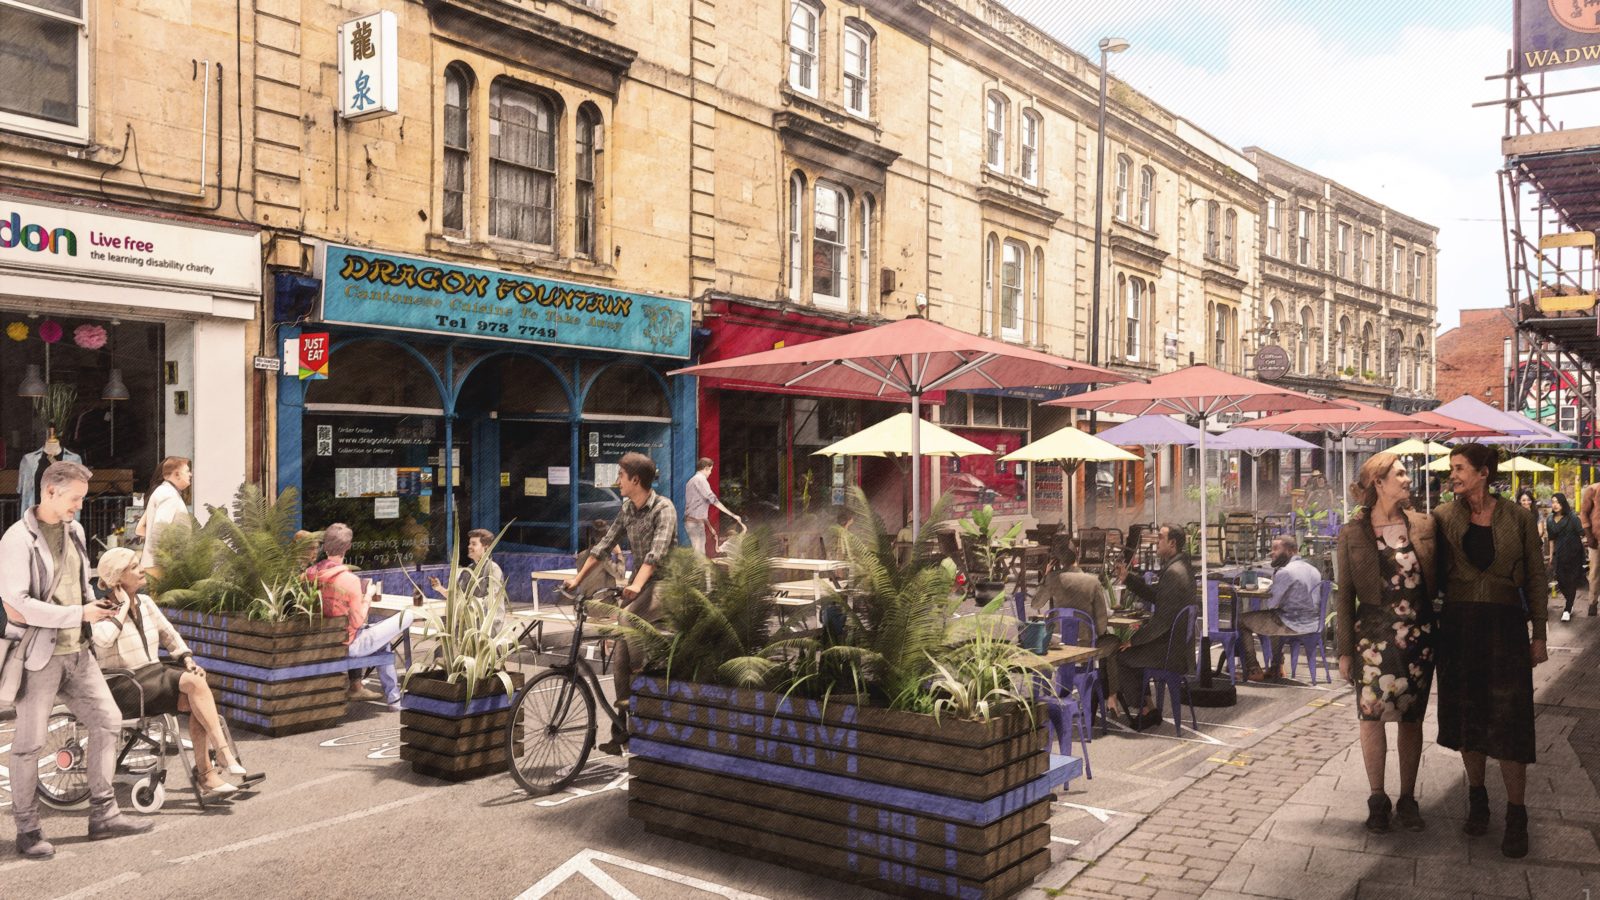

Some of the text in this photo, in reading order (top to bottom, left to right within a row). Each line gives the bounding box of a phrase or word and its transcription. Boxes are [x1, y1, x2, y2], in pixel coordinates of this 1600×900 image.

[350, 21, 376, 110] 龍泉
[90, 231, 154, 252] Live free
[90, 250, 215, 275] the learning disability charity
[339, 254, 633, 317] DRAGON FOUNTAIN
[344, 284, 442, 307] Cantonese
[450, 299, 513, 317] Cuisine
[545, 309, 581, 326] Take
[586, 316, 624, 332] Away
[436, 315, 557, 338] Tel 973 7749
[304, 338, 324, 351] JUST
[307, 350, 324, 361] EAT
[628, 675, 859, 773] COTHAM
